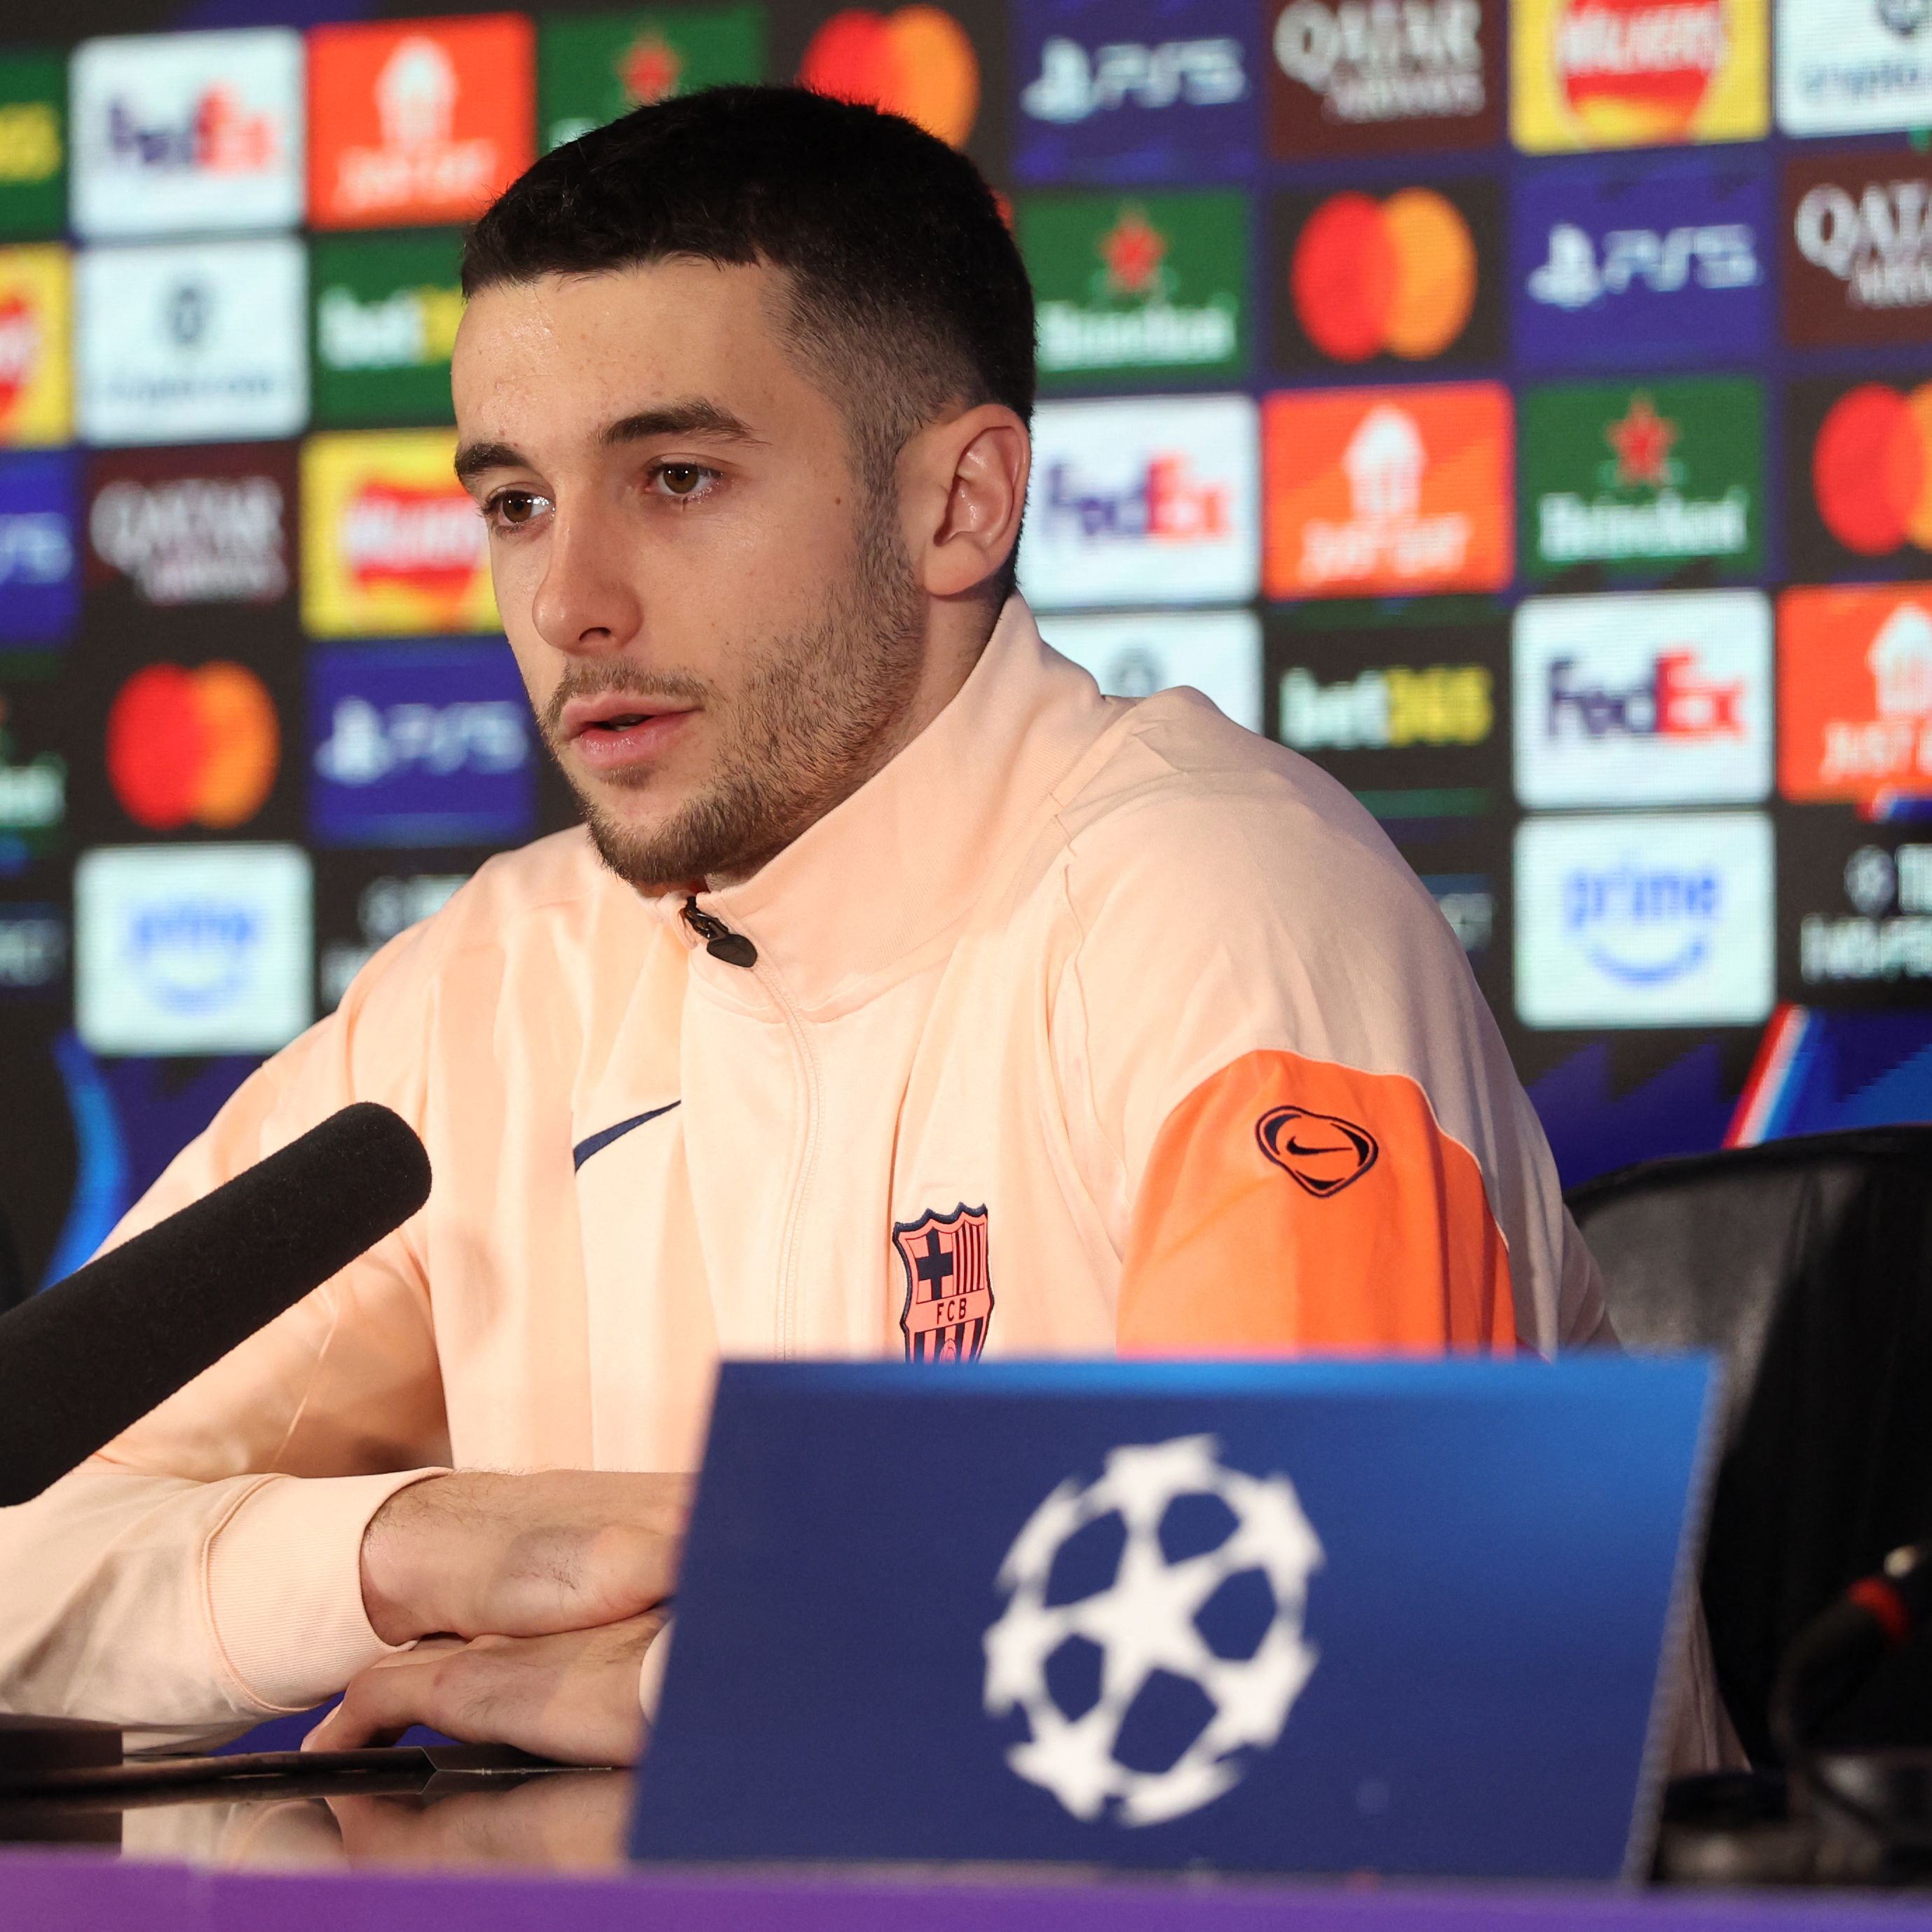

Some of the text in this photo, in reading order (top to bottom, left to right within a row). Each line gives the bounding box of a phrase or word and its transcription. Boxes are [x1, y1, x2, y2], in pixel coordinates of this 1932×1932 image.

[1793, 181, 1932, 282] QAT
[1043, 449, 1232, 543] FedEx
[1538, 487, 1748, 562] Heineken
[1279, 665, 1493, 750] bet365
[1546, 648, 1747, 744] FedEx
[1563, 854, 1723, 939] prime
[936, 1297, 967, 1326] FCB
